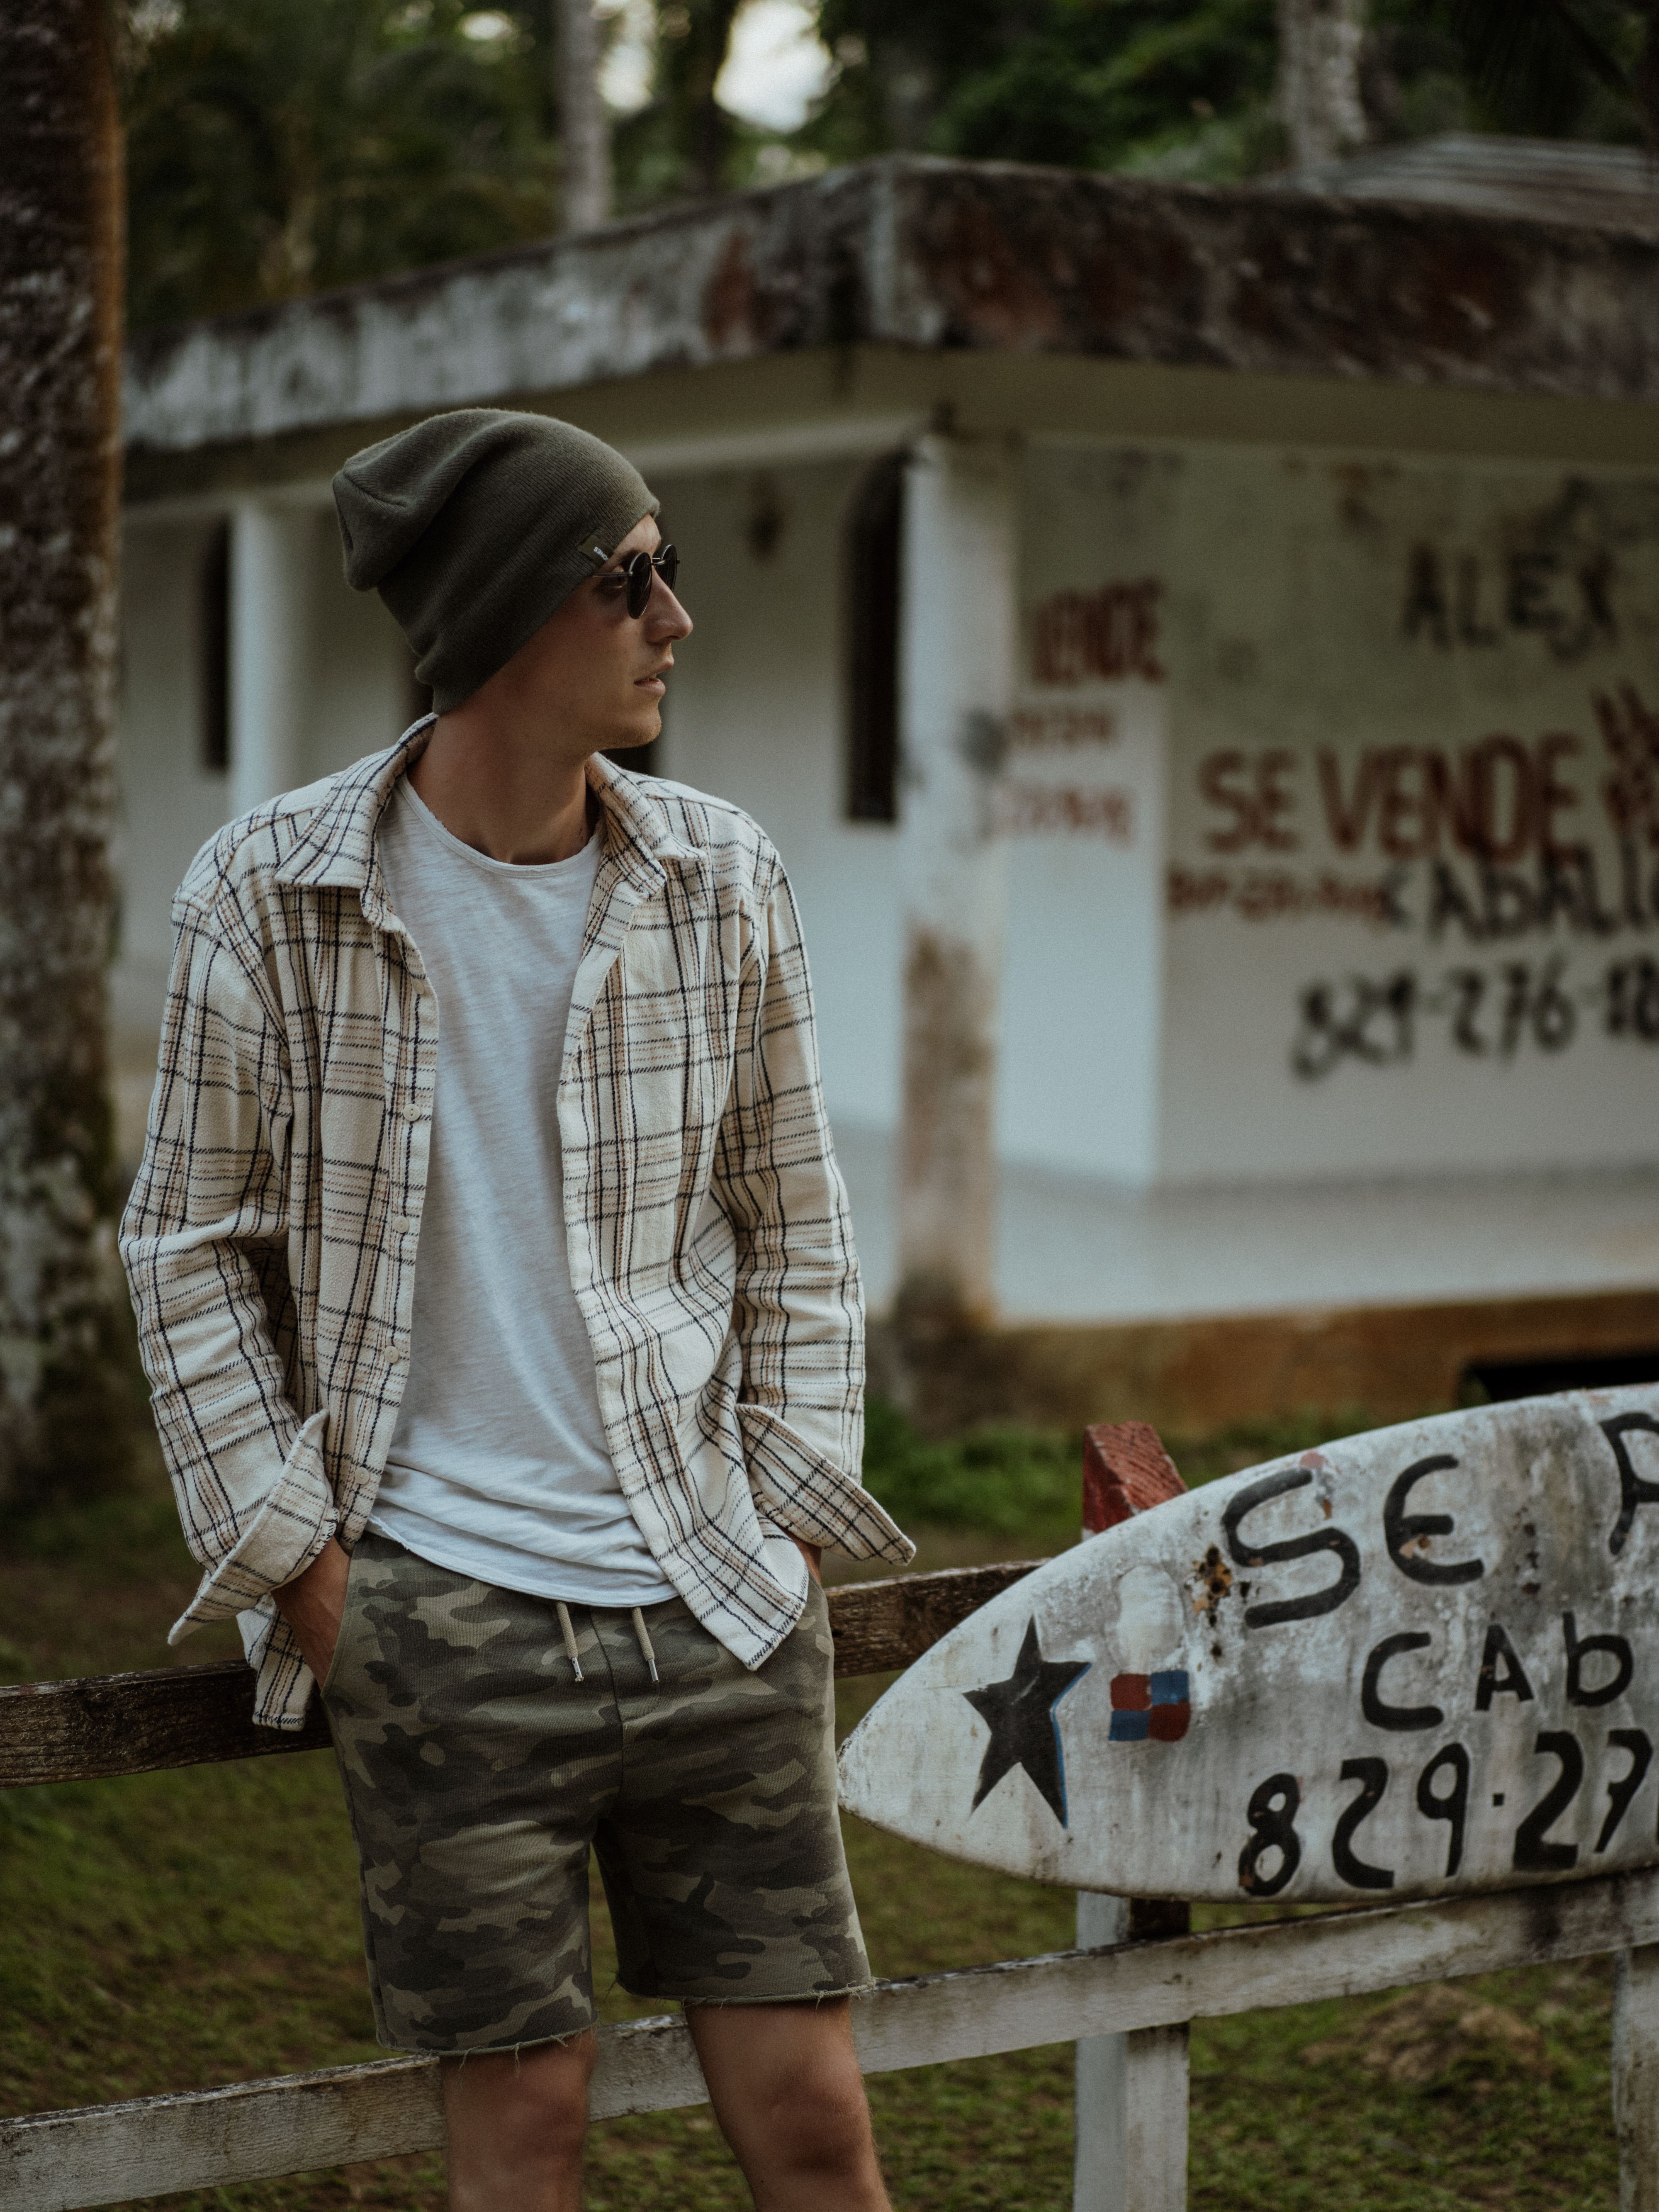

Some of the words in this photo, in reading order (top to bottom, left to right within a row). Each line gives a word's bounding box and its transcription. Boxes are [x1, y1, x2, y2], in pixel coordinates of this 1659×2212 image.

[1198, 747, 1298, 853] SE
[1314, 732, 1584, 867] VENDE
[1221, 1454, 1486, 1629] SE
